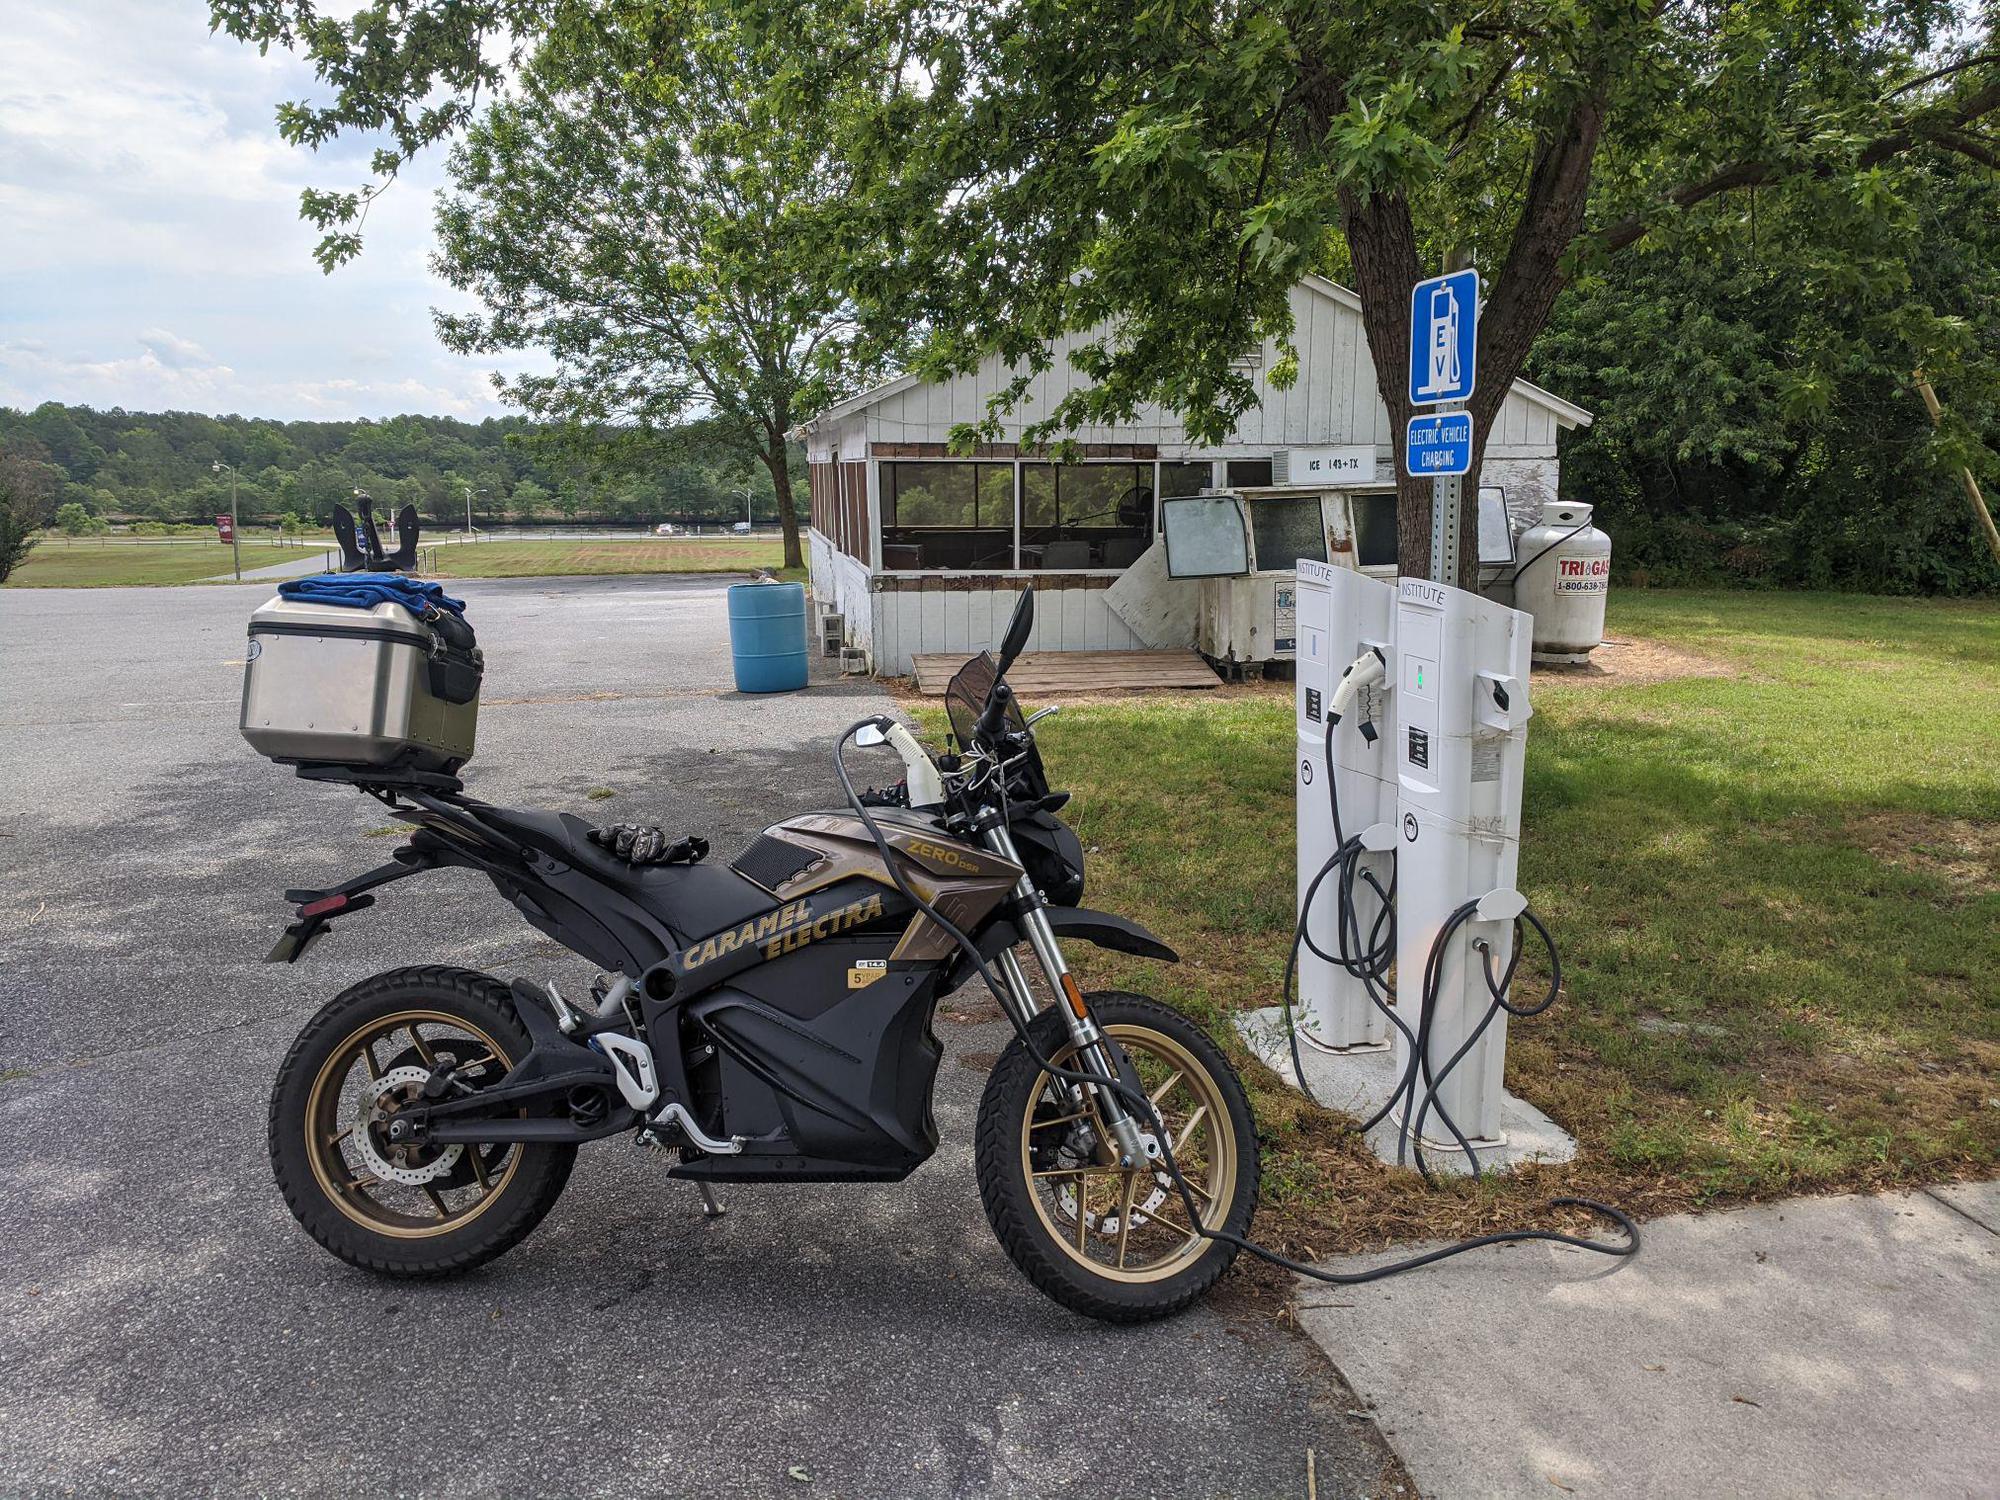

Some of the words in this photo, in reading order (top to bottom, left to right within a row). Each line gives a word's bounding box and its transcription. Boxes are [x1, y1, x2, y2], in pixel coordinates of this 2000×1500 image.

[1410, 428, 1439, 446] ELECTRIC
[1441, 425, 1468, 443] VEHICLE
[1309, 459, 1320, 471] ICE
[1421, 449, 1455, 467] CHARGING
[1298, 562, 1333, 582] STITUTE
[1560, 560, 1585, 576] TRI
[1401, 582, 1446, 606] NSTITUTE
[907, 840, 960, 865] ZERO
[959, 861, 980, 873] DSR
[683, 899, 811, 971] CARAMEL
[766, 893, 884, 960] ELECTRA
[854, 973, 862, 984] 5
